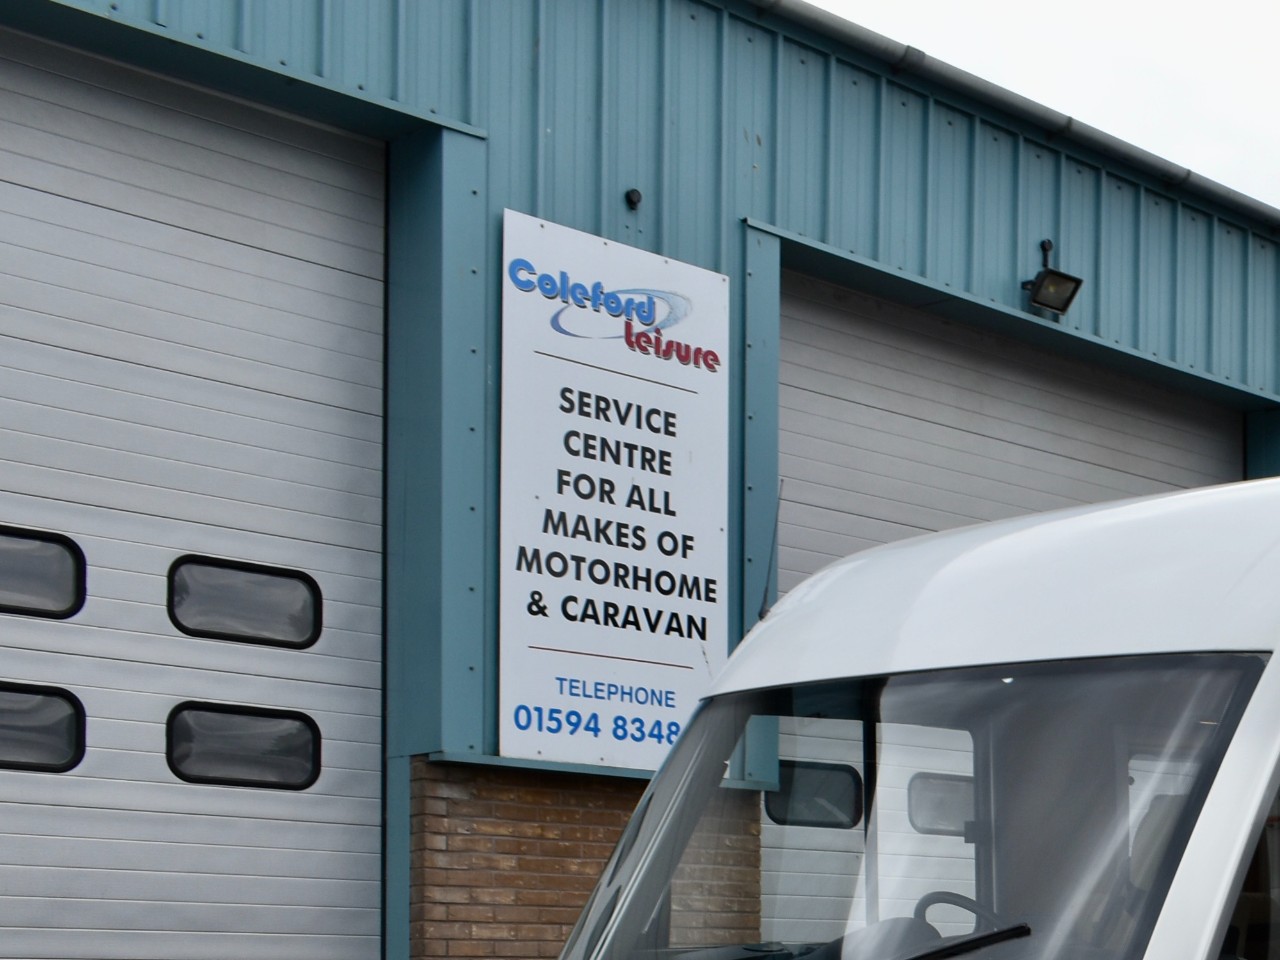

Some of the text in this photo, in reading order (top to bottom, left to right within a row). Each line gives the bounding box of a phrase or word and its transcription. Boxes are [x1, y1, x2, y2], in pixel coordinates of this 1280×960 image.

[508, 258, 656, 326] Coleford
[559, 387, 677, 437] SERVICE
[563, 430, 672, 476] CENTRE
[557, 469, 677, 517] FOR ALL
[542, 508, 695, 559] MAKES OF
[515, 545, 717, 603] MOTORHOME
[527, 590, 707, 641] & CARAVAN
[555, 676, 676, 708] TELEPHONE
[513, 704, 601, 738] 01594
